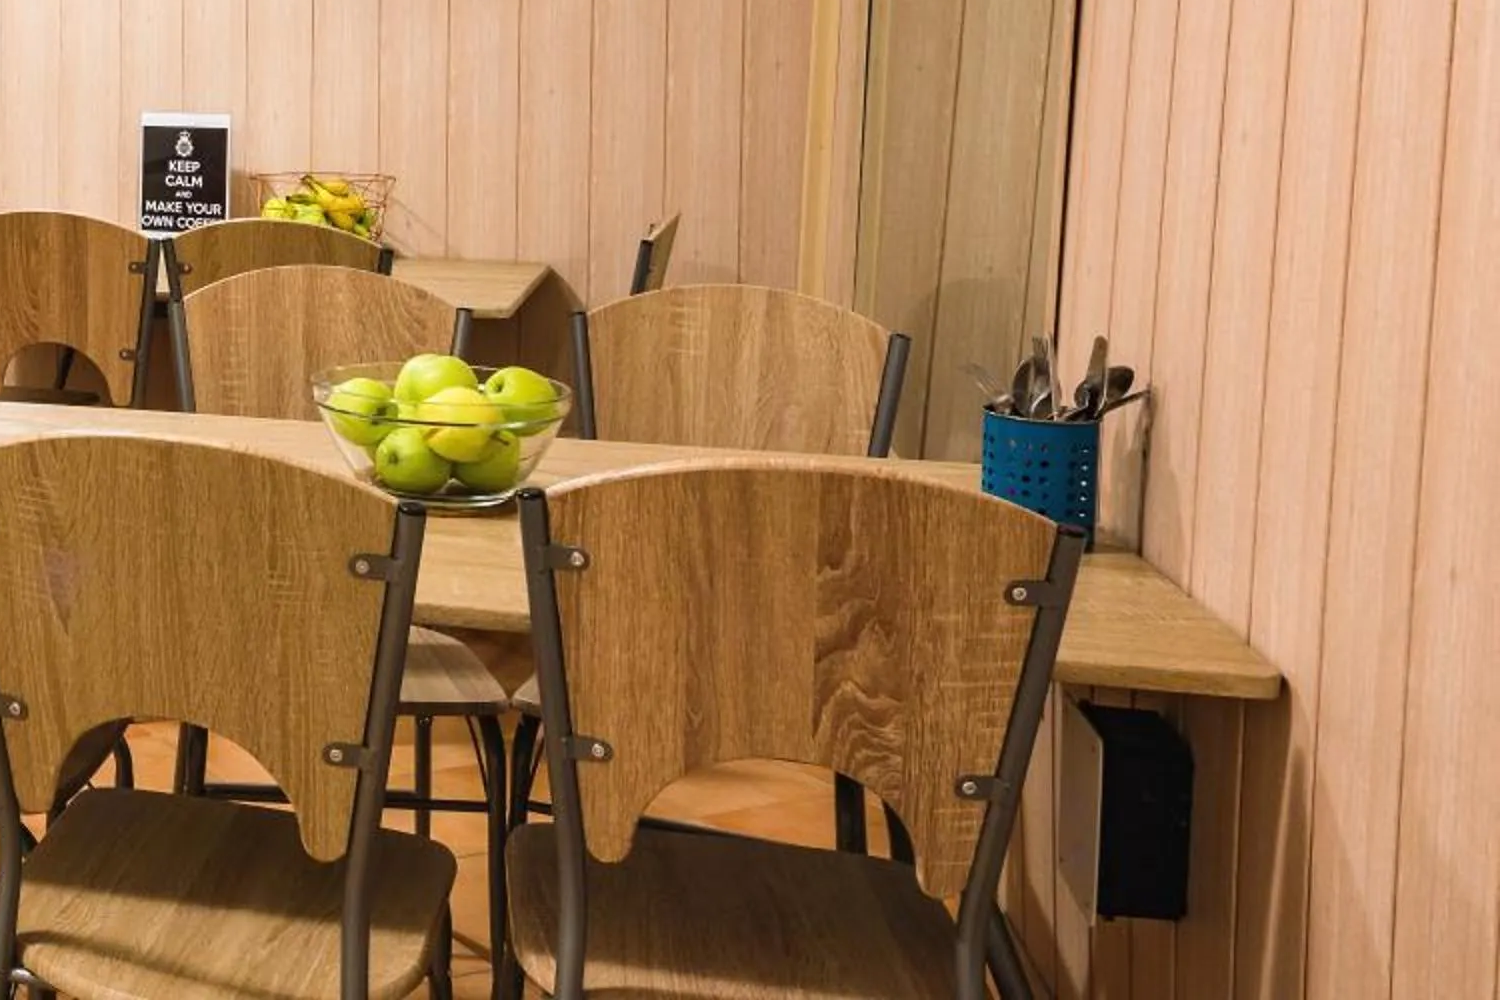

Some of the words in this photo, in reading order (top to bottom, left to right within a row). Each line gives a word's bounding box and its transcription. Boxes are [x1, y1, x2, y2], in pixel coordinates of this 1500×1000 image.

[168, 159, 201, 172] KEEP
[165, 175, 203, 188] CALM
[145, 200, 183, 214] MAKE
[186, 202, 222, 216] YOUR
[141, 215, 175, 228] OWN
